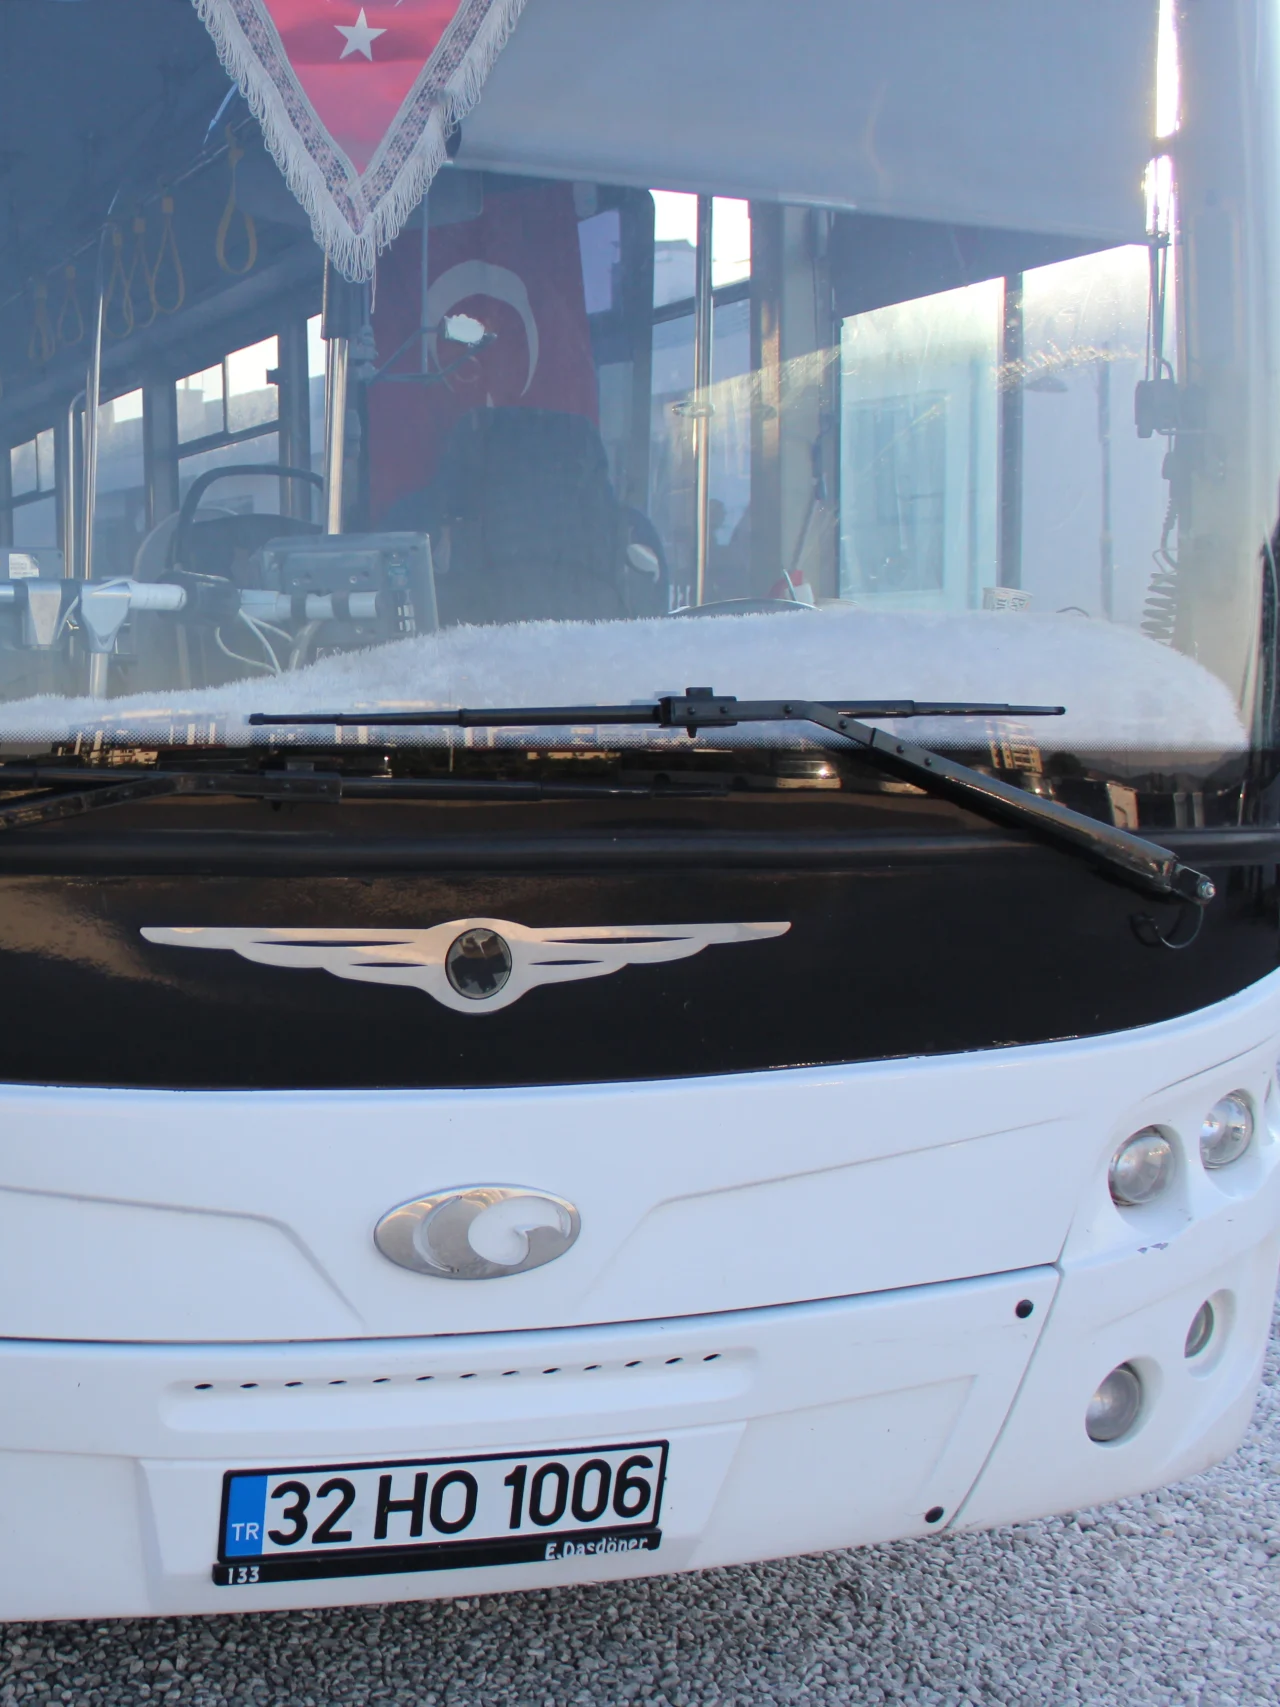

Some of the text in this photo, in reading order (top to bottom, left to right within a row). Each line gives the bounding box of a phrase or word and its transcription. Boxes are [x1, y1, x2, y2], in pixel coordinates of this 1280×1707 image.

[267, 1454, 655, 1547] 32 HO 1006
[231, 1522, 260, 1542] TR
[227, 1565, 260, 1585] 133
